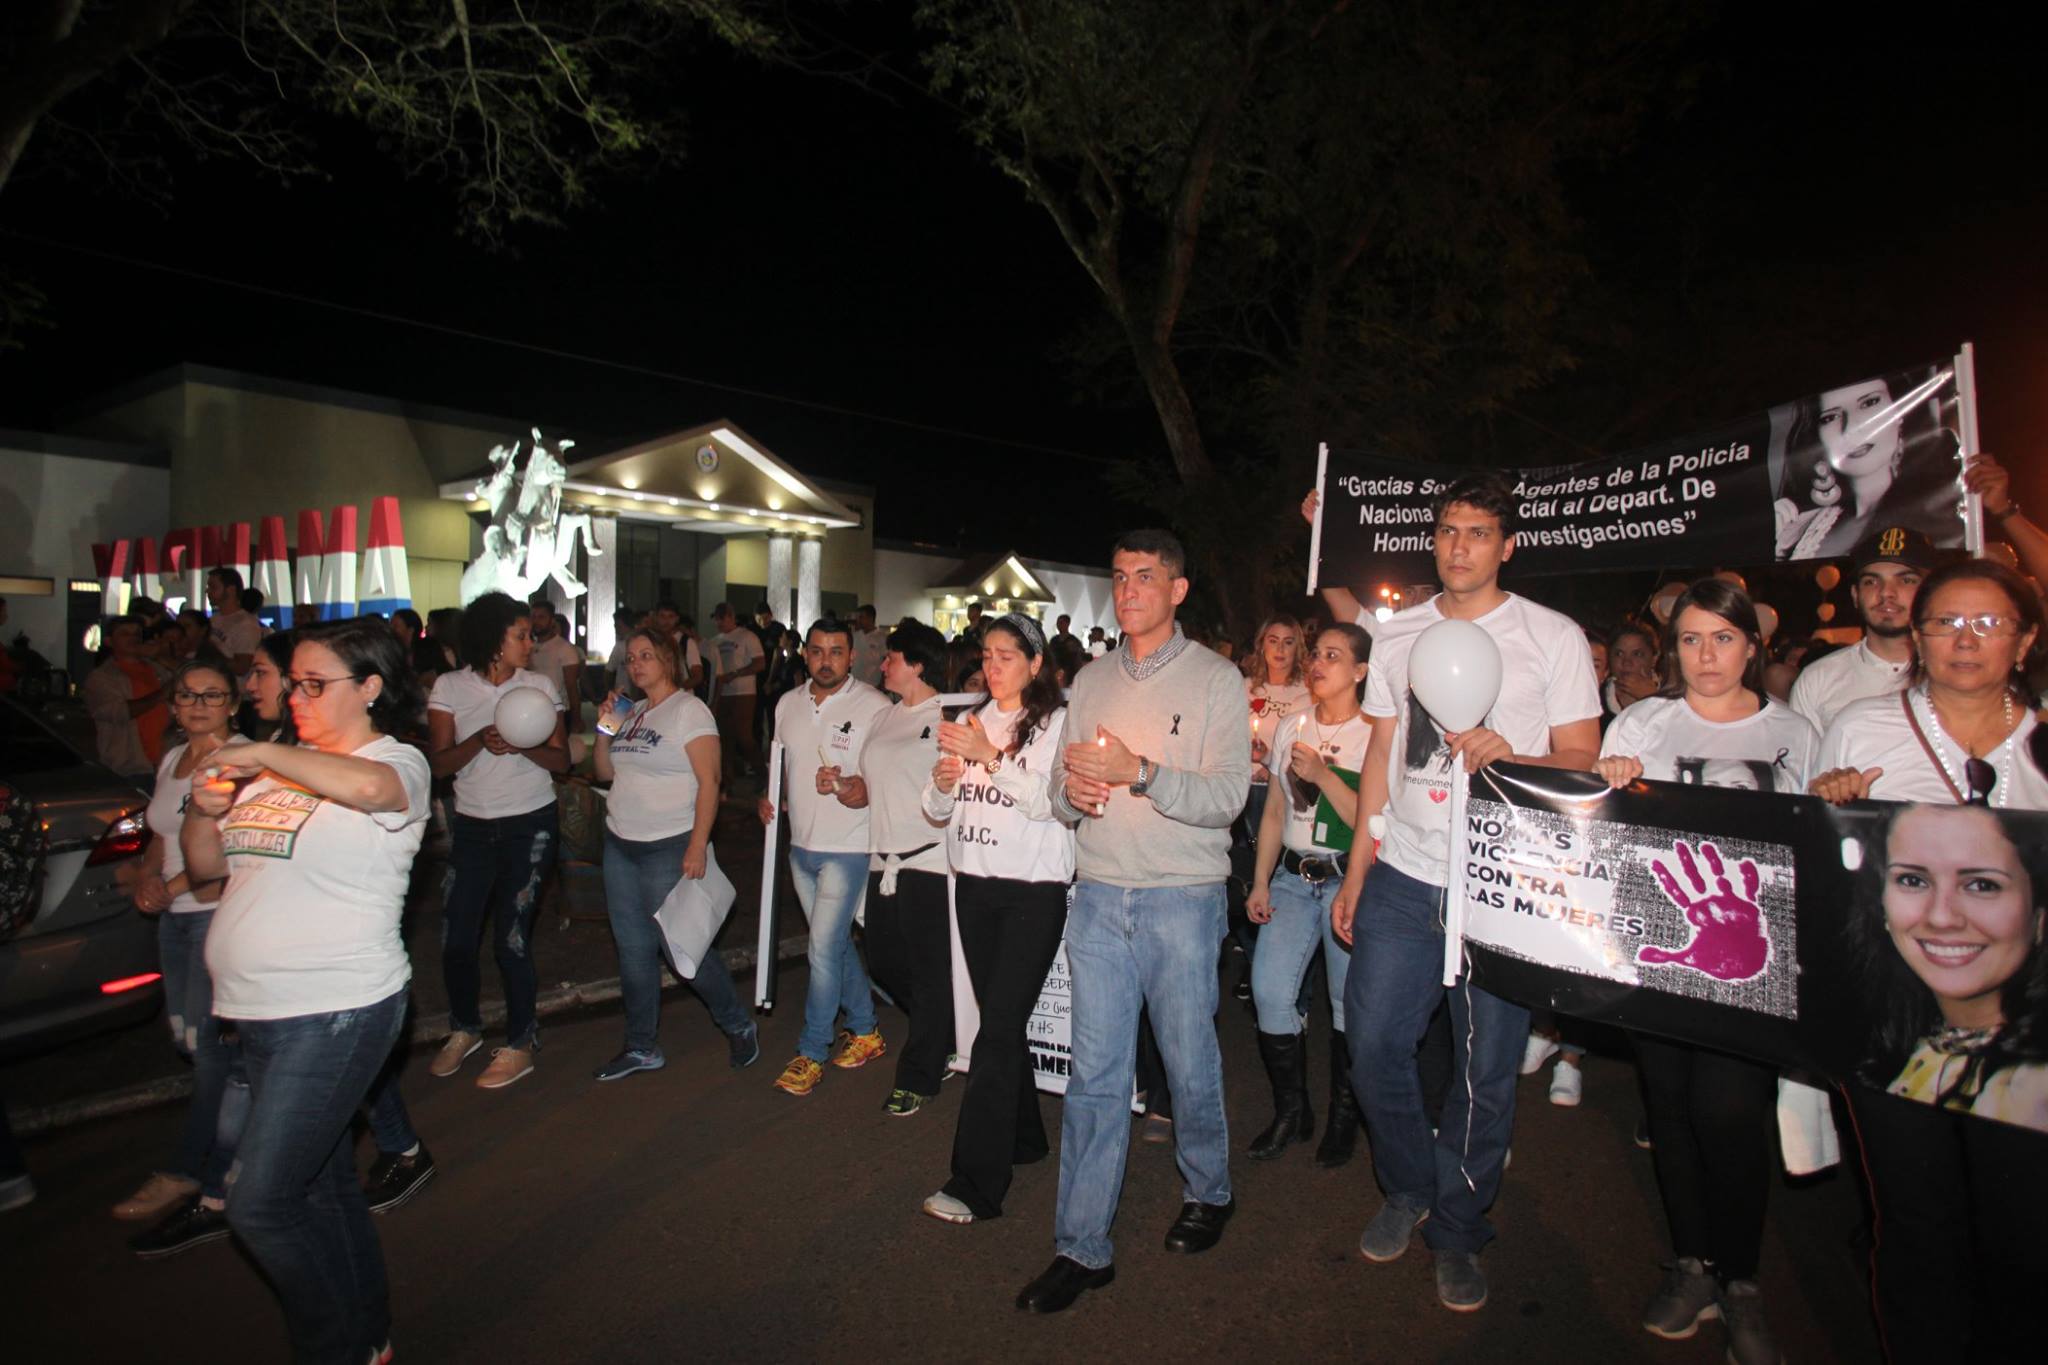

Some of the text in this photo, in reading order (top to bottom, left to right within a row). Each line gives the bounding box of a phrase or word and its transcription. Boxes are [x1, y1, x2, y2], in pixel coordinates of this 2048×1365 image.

[1419, 478, 1457, 496] Se
[1512, 475, 1599, 499] Agentes
[1606, 467, 1634, 487] de
[1640, 462, 1661, 481] la
[1667, 442, 1751, 476] Policía
[1359, 503, 1435, 524] Naciona
[1562, 497, 1585, 516] al
[1589, 483, 1674, 515] Depart.
[1682, 477, 1717, 501] De
[1468, 816, 1502, 837] NO
[1467, 862, 1567, 898] CONTRA
[1466, 883, 1643, 936] LAS MUJERES
